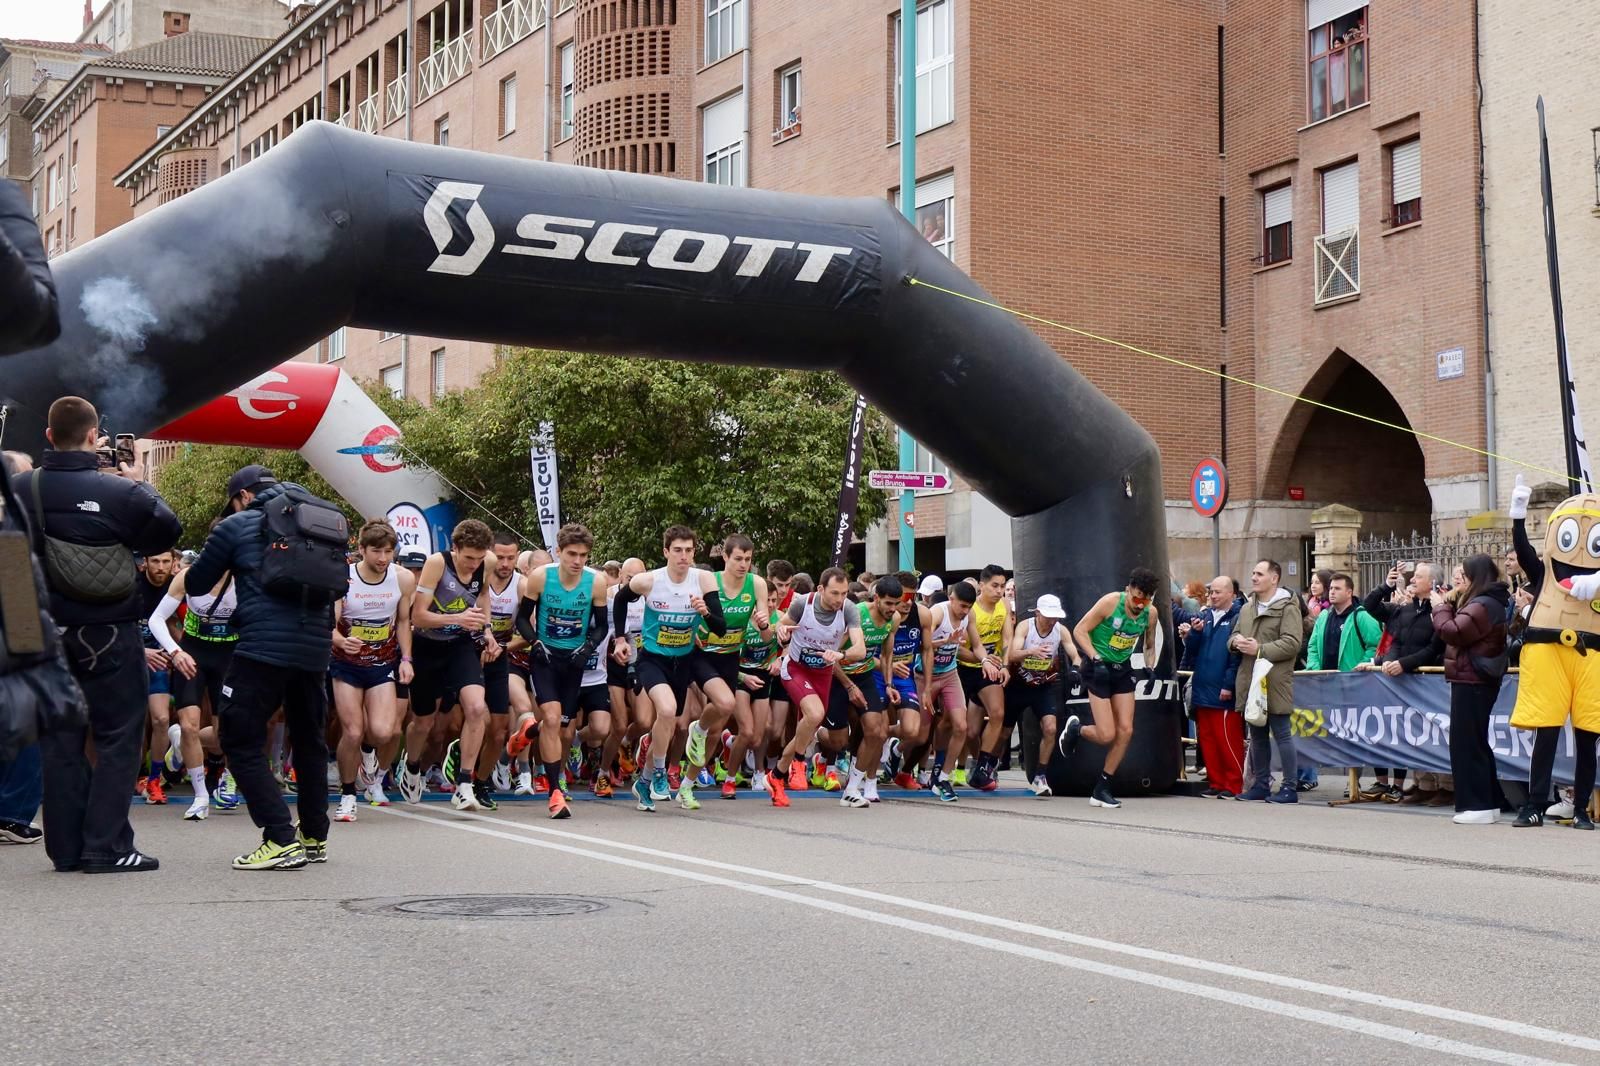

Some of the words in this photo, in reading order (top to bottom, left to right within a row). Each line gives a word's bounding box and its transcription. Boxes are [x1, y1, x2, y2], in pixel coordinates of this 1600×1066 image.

[501, 213, 852, 283] SCOTT
[546, 607, 586, 616] ATLEET
[658, 614, 697, 623] ATLEET
[212, 625, 228, 633] 91
[556, 626, 572, 634] 24
